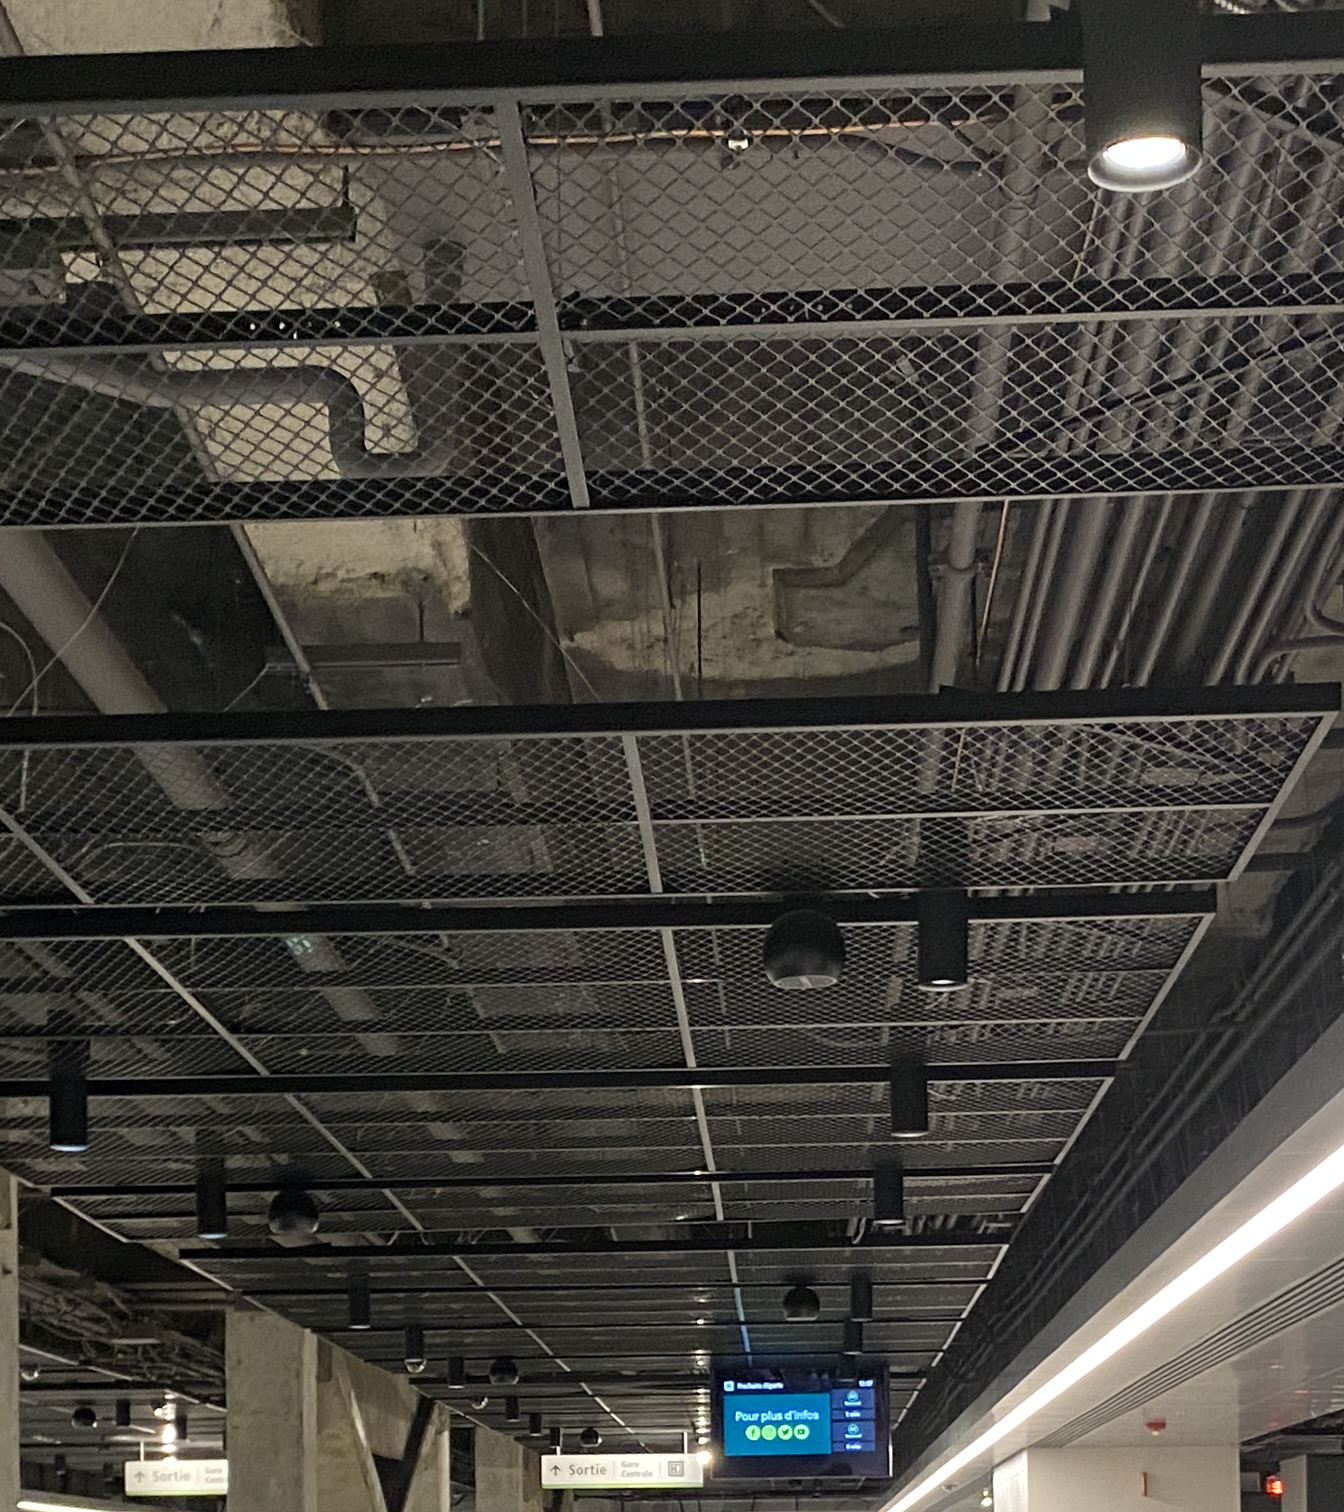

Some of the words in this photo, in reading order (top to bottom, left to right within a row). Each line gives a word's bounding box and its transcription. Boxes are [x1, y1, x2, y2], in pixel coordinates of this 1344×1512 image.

[735, 1411, 759, 1422] Pour
[761, 1410, 783, 1423] plus
[784, 1410, 819, 1421] d'infos
[152, 1470, 191, 1482] Sortie
[568, 1464, 607, 1476] Sortie
